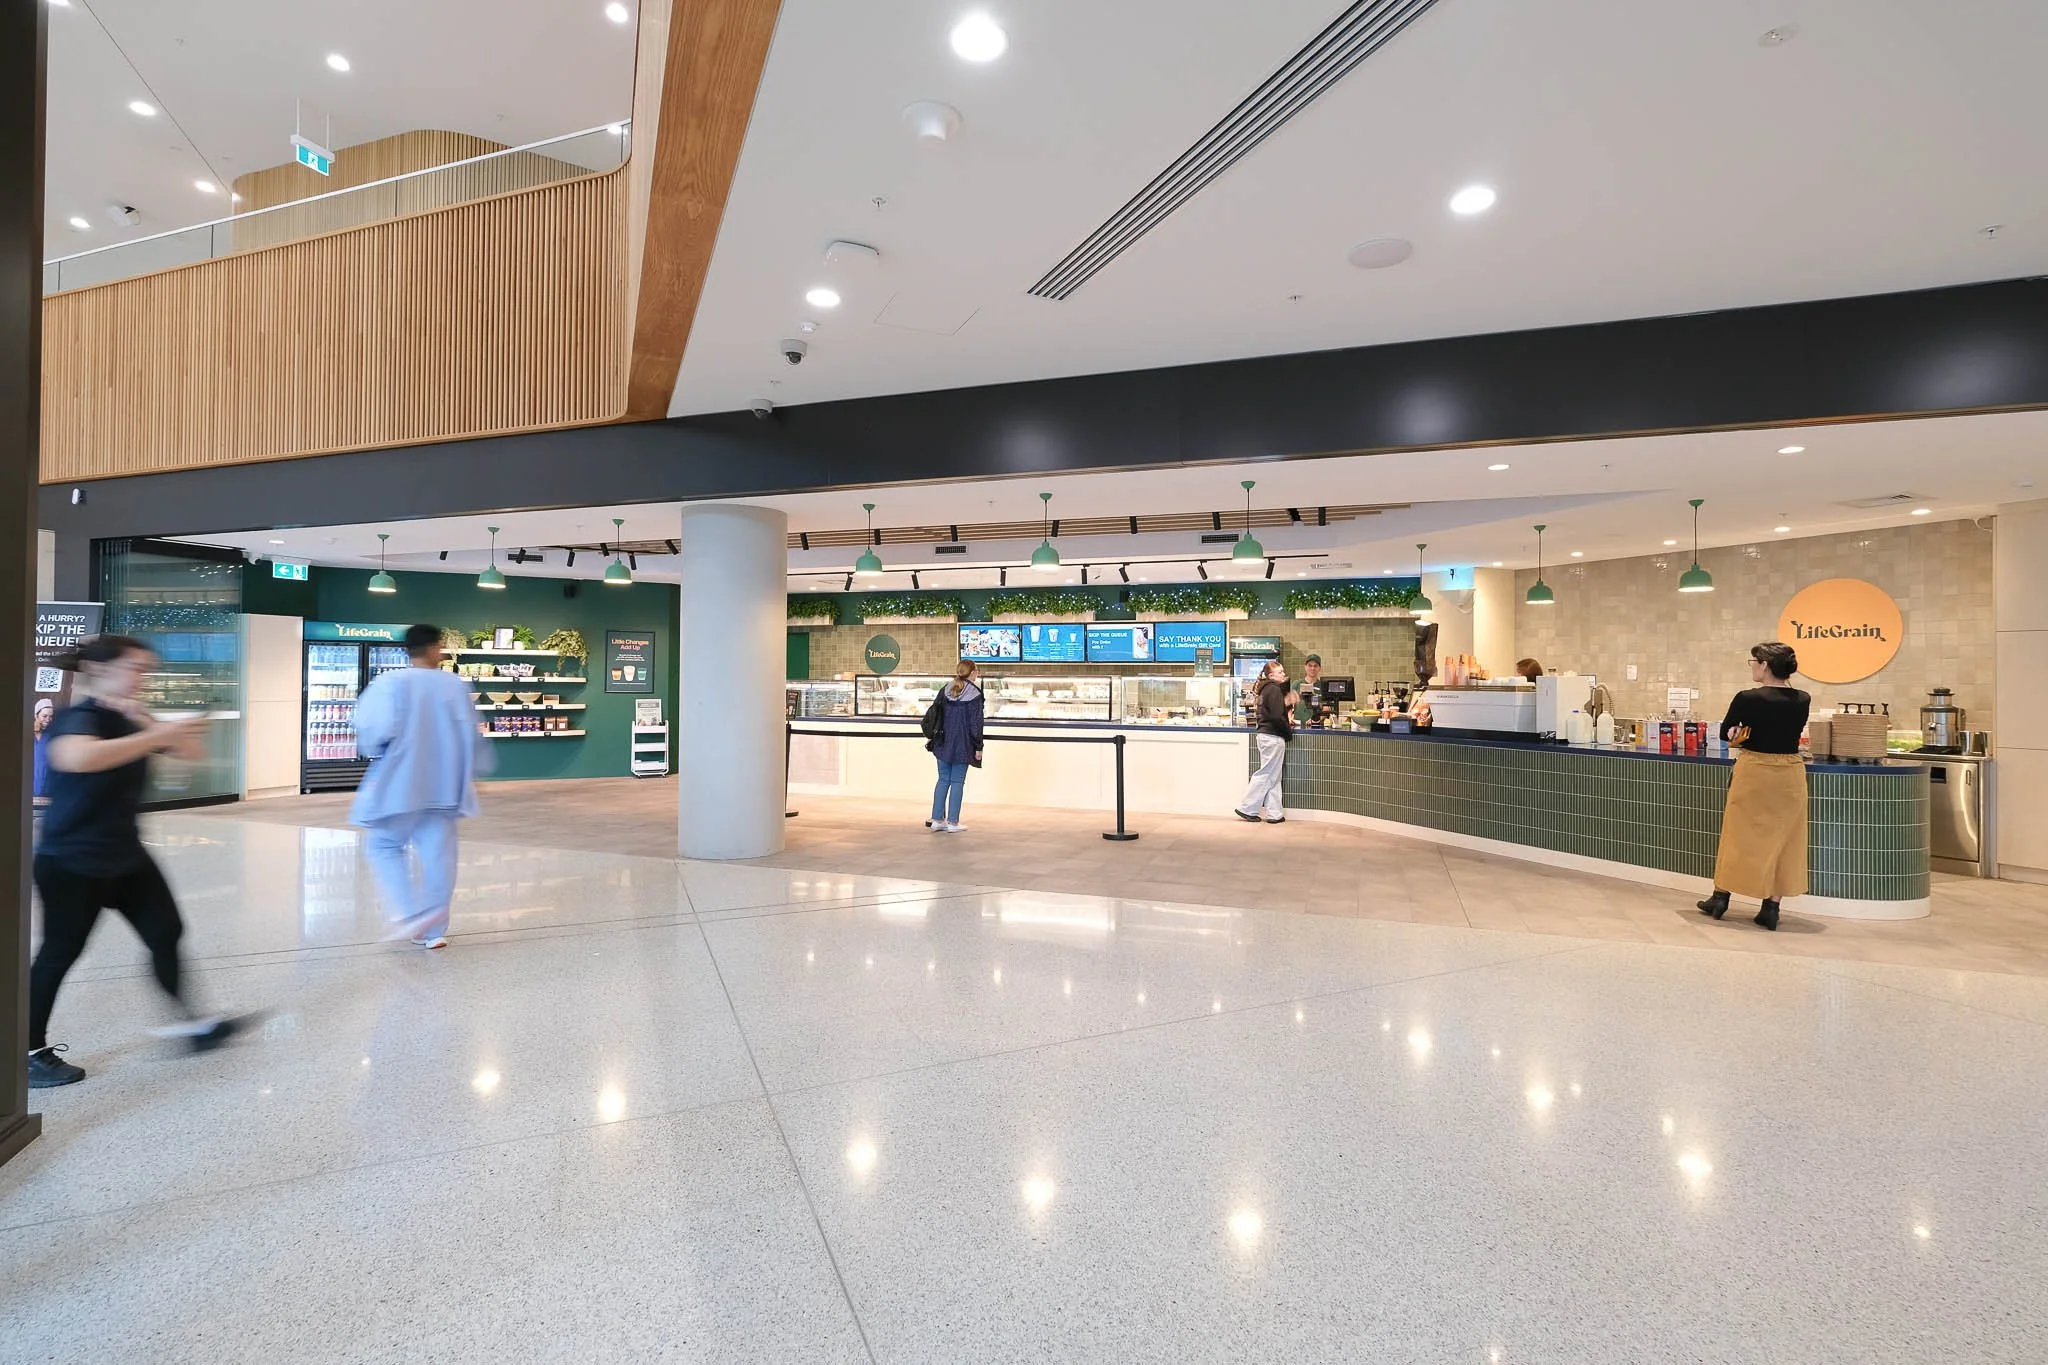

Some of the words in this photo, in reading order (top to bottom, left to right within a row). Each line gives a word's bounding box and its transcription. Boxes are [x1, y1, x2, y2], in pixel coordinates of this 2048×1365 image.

[35, 624, 56, 634] KIP
[58, 624, 86, 635] THE
[335, 624, 393, 640] LifeGrain
[1791, 621, 1886, 641] LifeGrain
[1159, 635, 1175, 643] SAY
[1176, 635, 1203, 643] THANK
